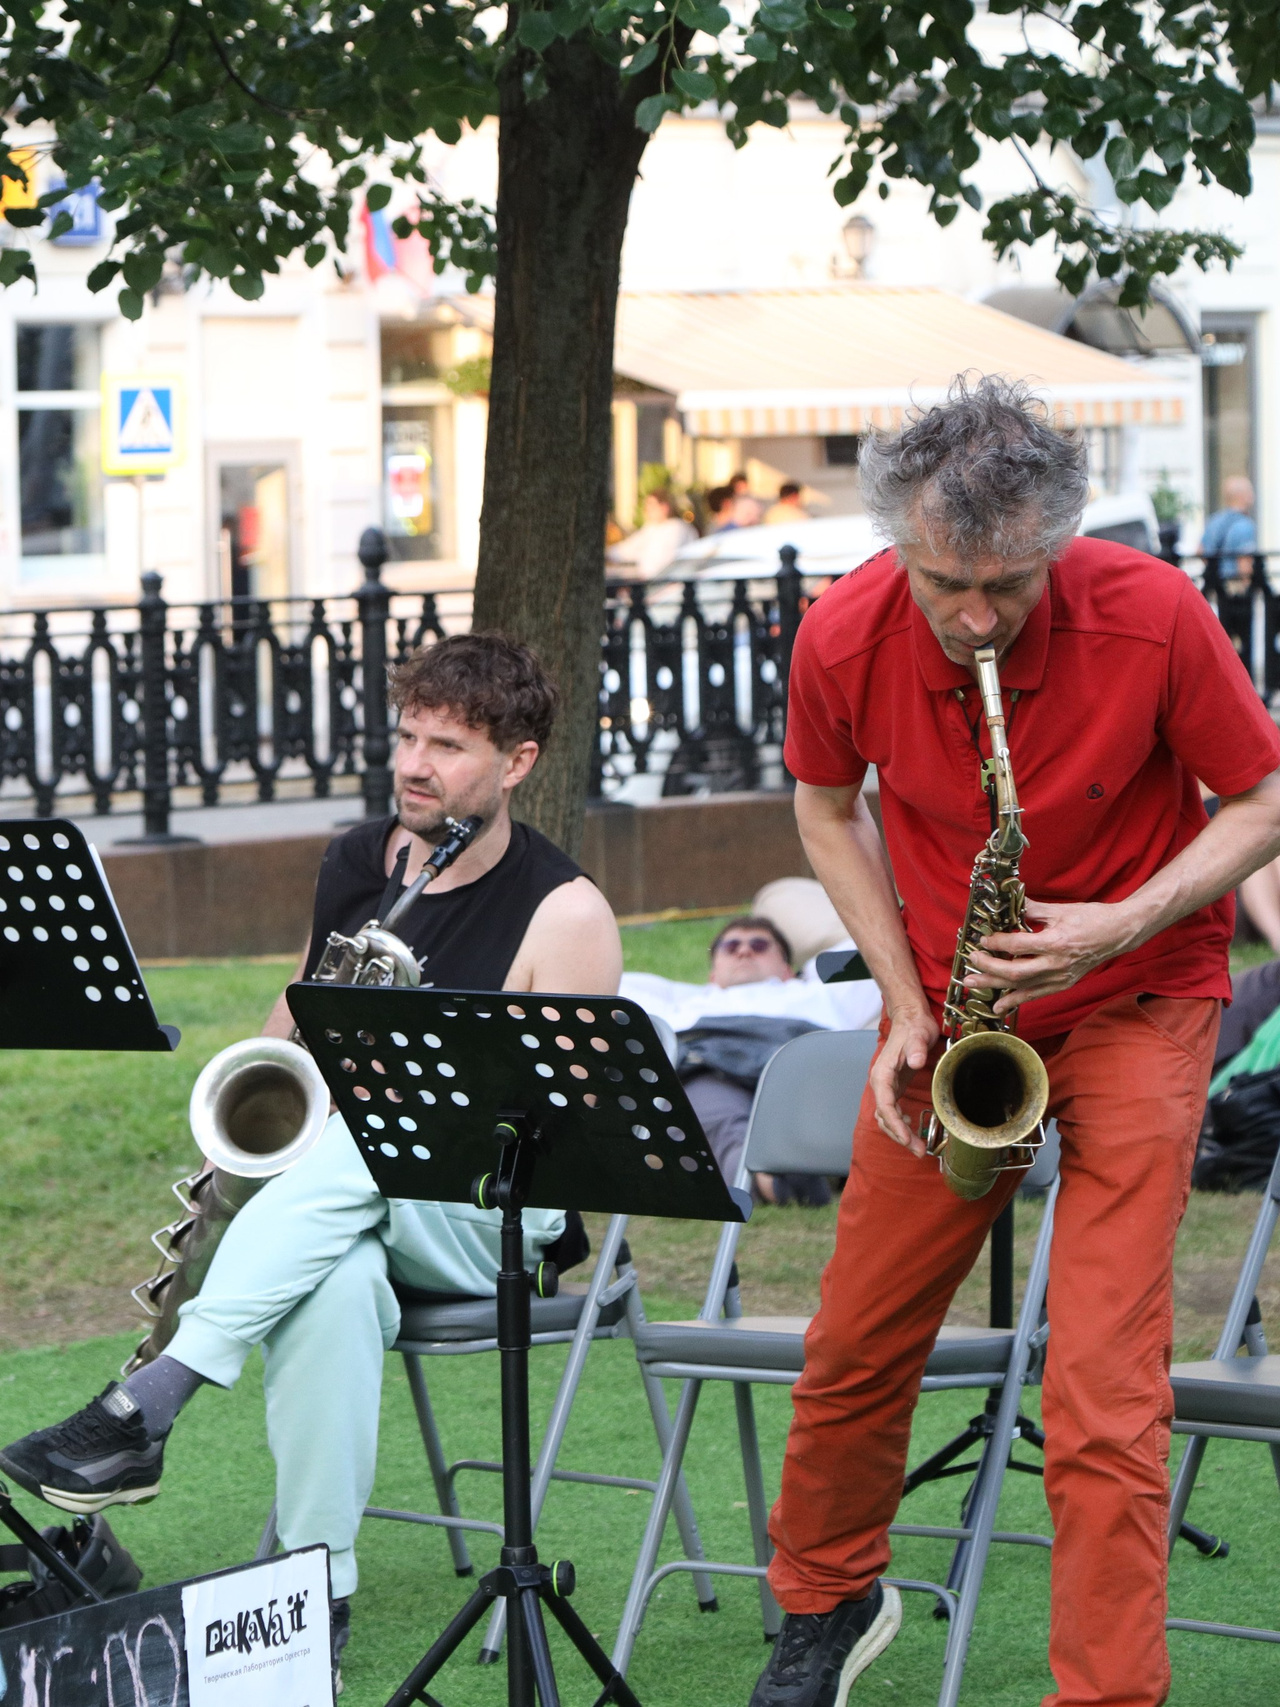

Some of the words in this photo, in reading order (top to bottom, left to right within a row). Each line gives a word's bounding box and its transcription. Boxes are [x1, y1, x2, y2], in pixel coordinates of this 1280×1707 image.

[204, 1669, 242, 1684] Творческая
[243, 1656, 284, 1673] Лаборатория
[284, 1648, 311, 1662] Оркестра
